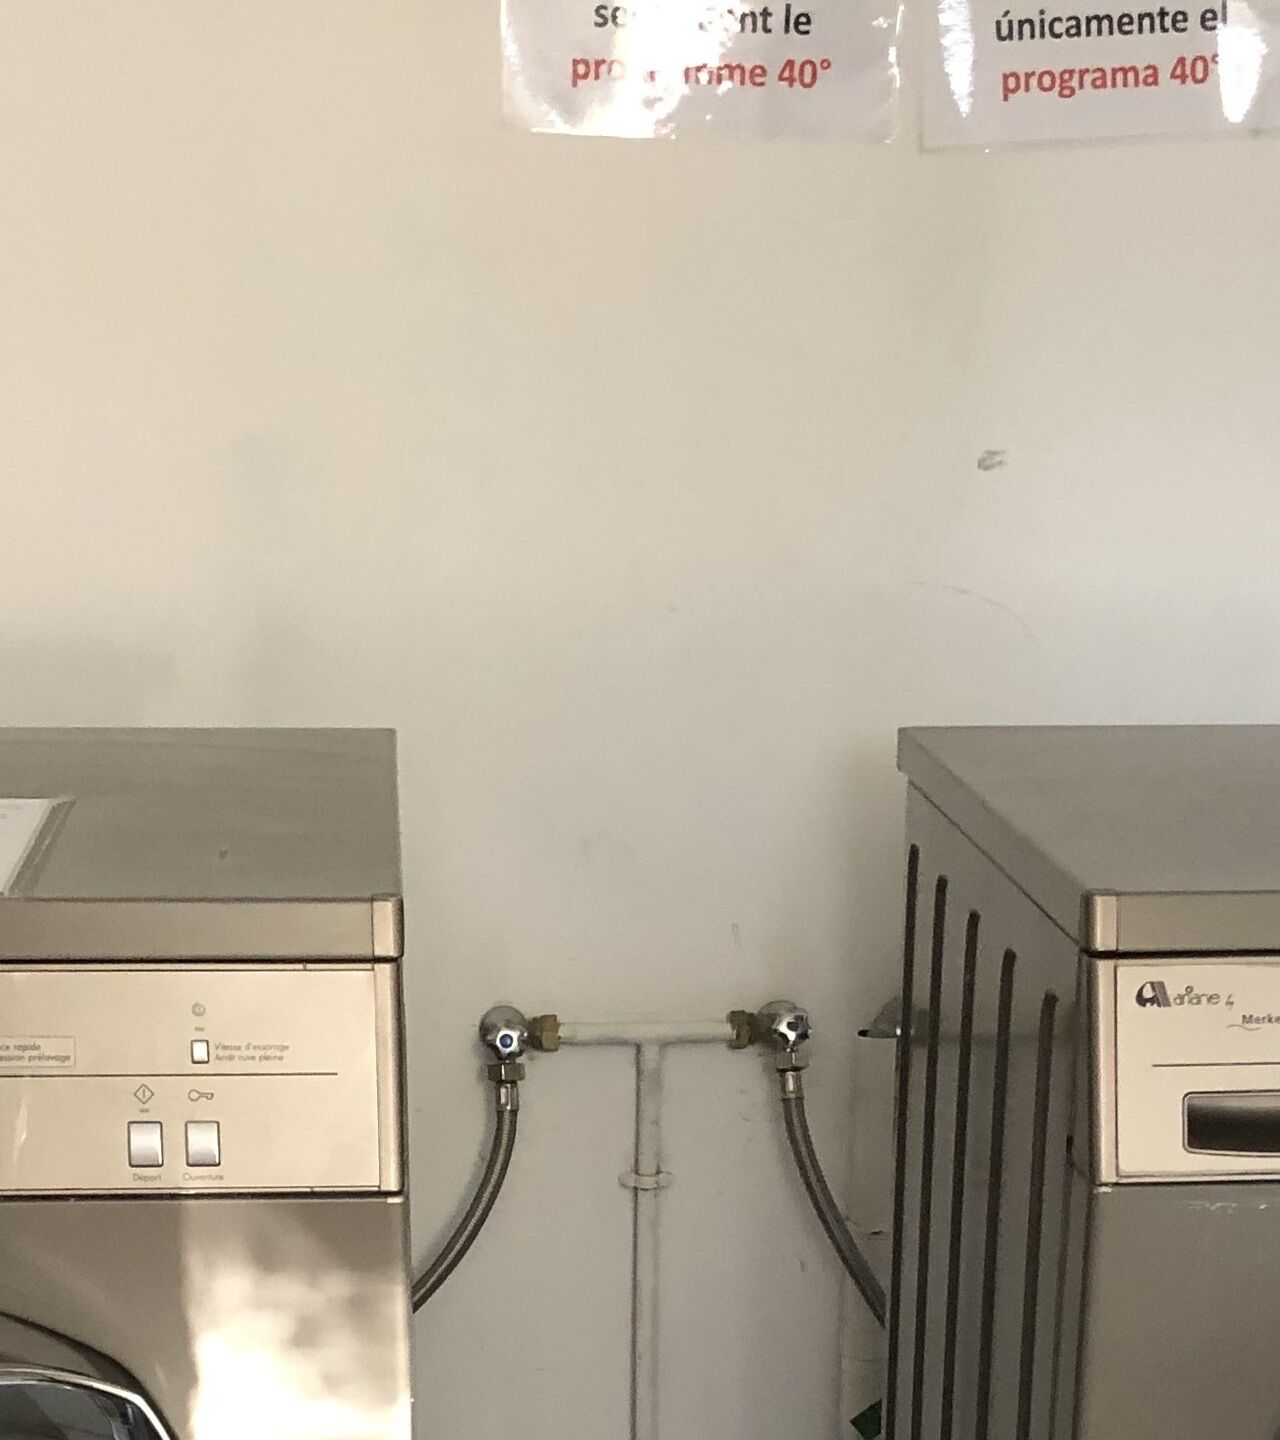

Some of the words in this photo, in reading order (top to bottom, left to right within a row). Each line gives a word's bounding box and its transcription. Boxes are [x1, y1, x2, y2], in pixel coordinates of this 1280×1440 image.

[784, 3, 812, 36] le
[995, 5, 1189, 42] únicamente
[1200, 0, 1228, 33] el
[778, 58, 833, 89] 40°
[1002, 62, 1160, 102] programa
